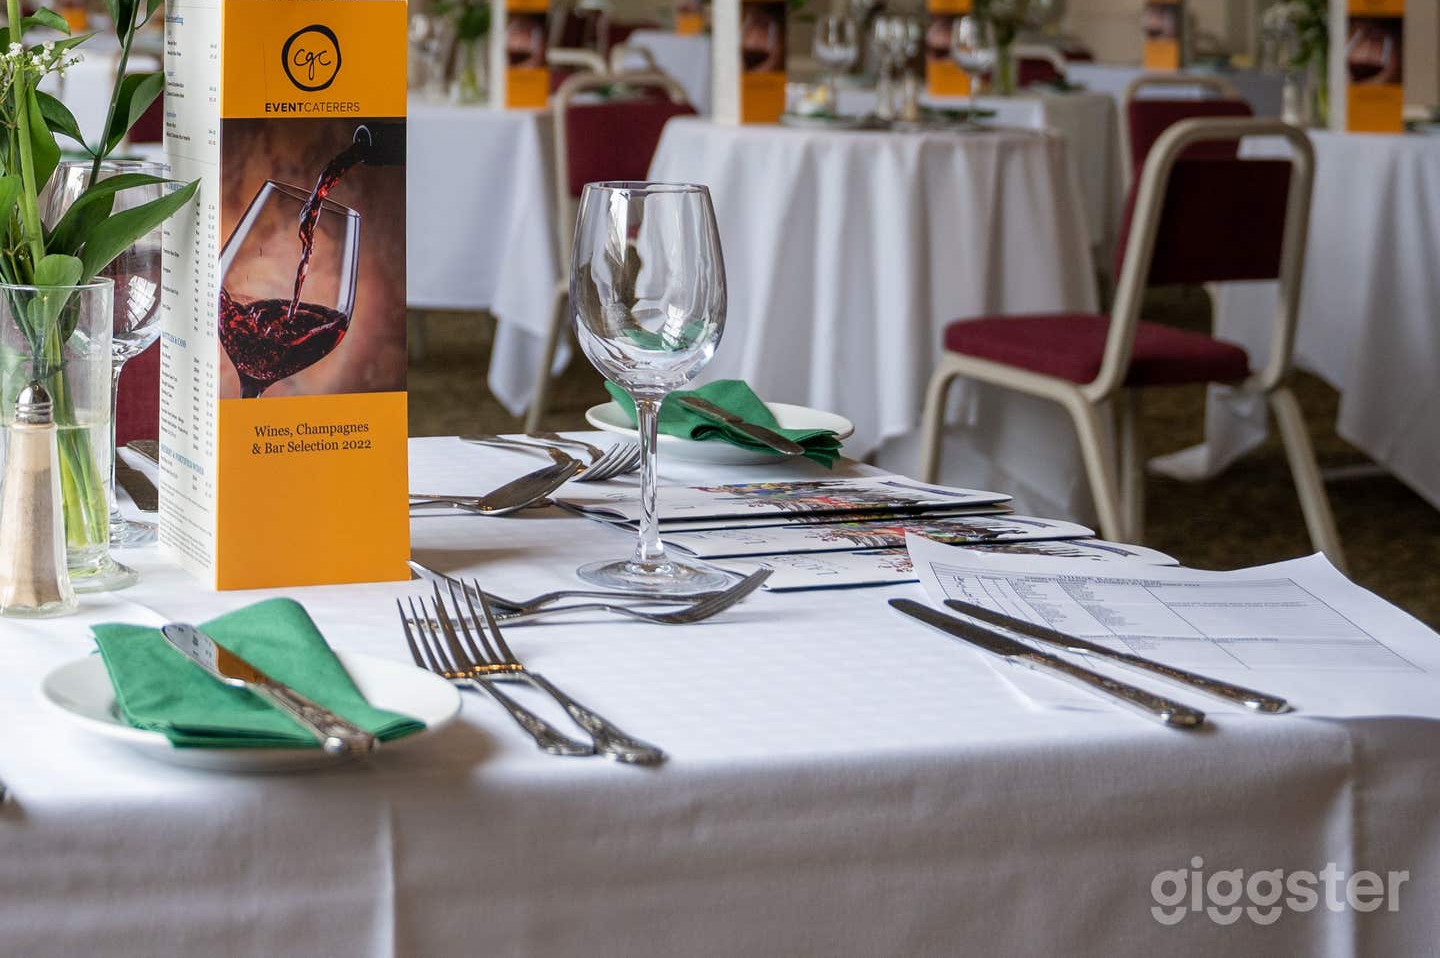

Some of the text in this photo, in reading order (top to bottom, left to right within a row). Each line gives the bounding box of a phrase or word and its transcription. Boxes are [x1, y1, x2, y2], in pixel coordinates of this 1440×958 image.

[293, 48, 331, 81] cgc
[264, 102, 360, 112] EVENTCATERERS
[254, 422, 369, 437] Wines, Champagnes
[252, 439, 371, 455] & Bar Selection 2022
